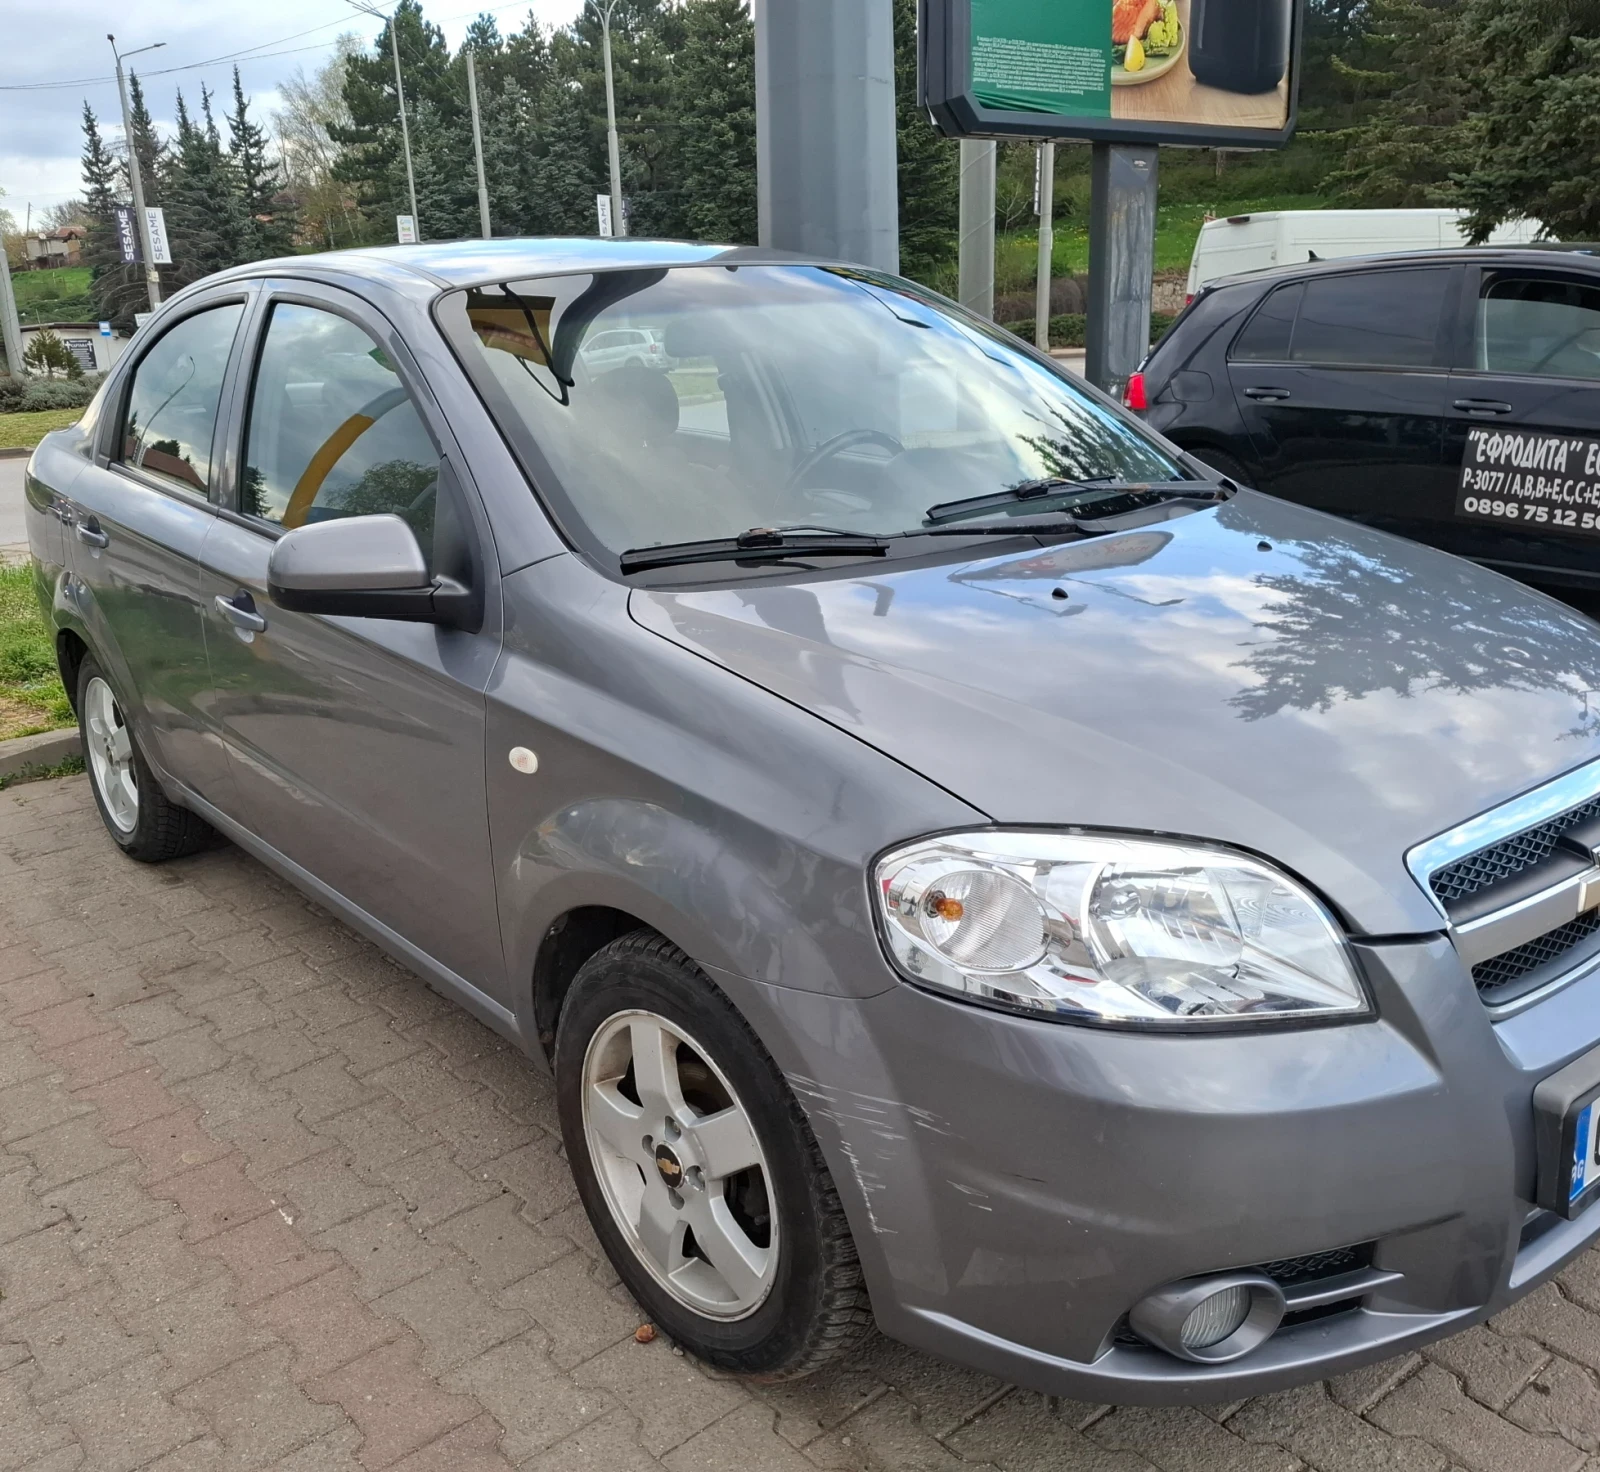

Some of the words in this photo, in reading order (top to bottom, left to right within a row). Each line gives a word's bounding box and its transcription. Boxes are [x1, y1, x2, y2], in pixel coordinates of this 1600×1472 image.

[118, 209, 135, 261] SESAME
[148, 211, 164, 261] SESAME
[1464, 496, 1519, 518] 0896
[1523, 504, 1549, 522] 75
[1552, 509, 1577, 526] 12
